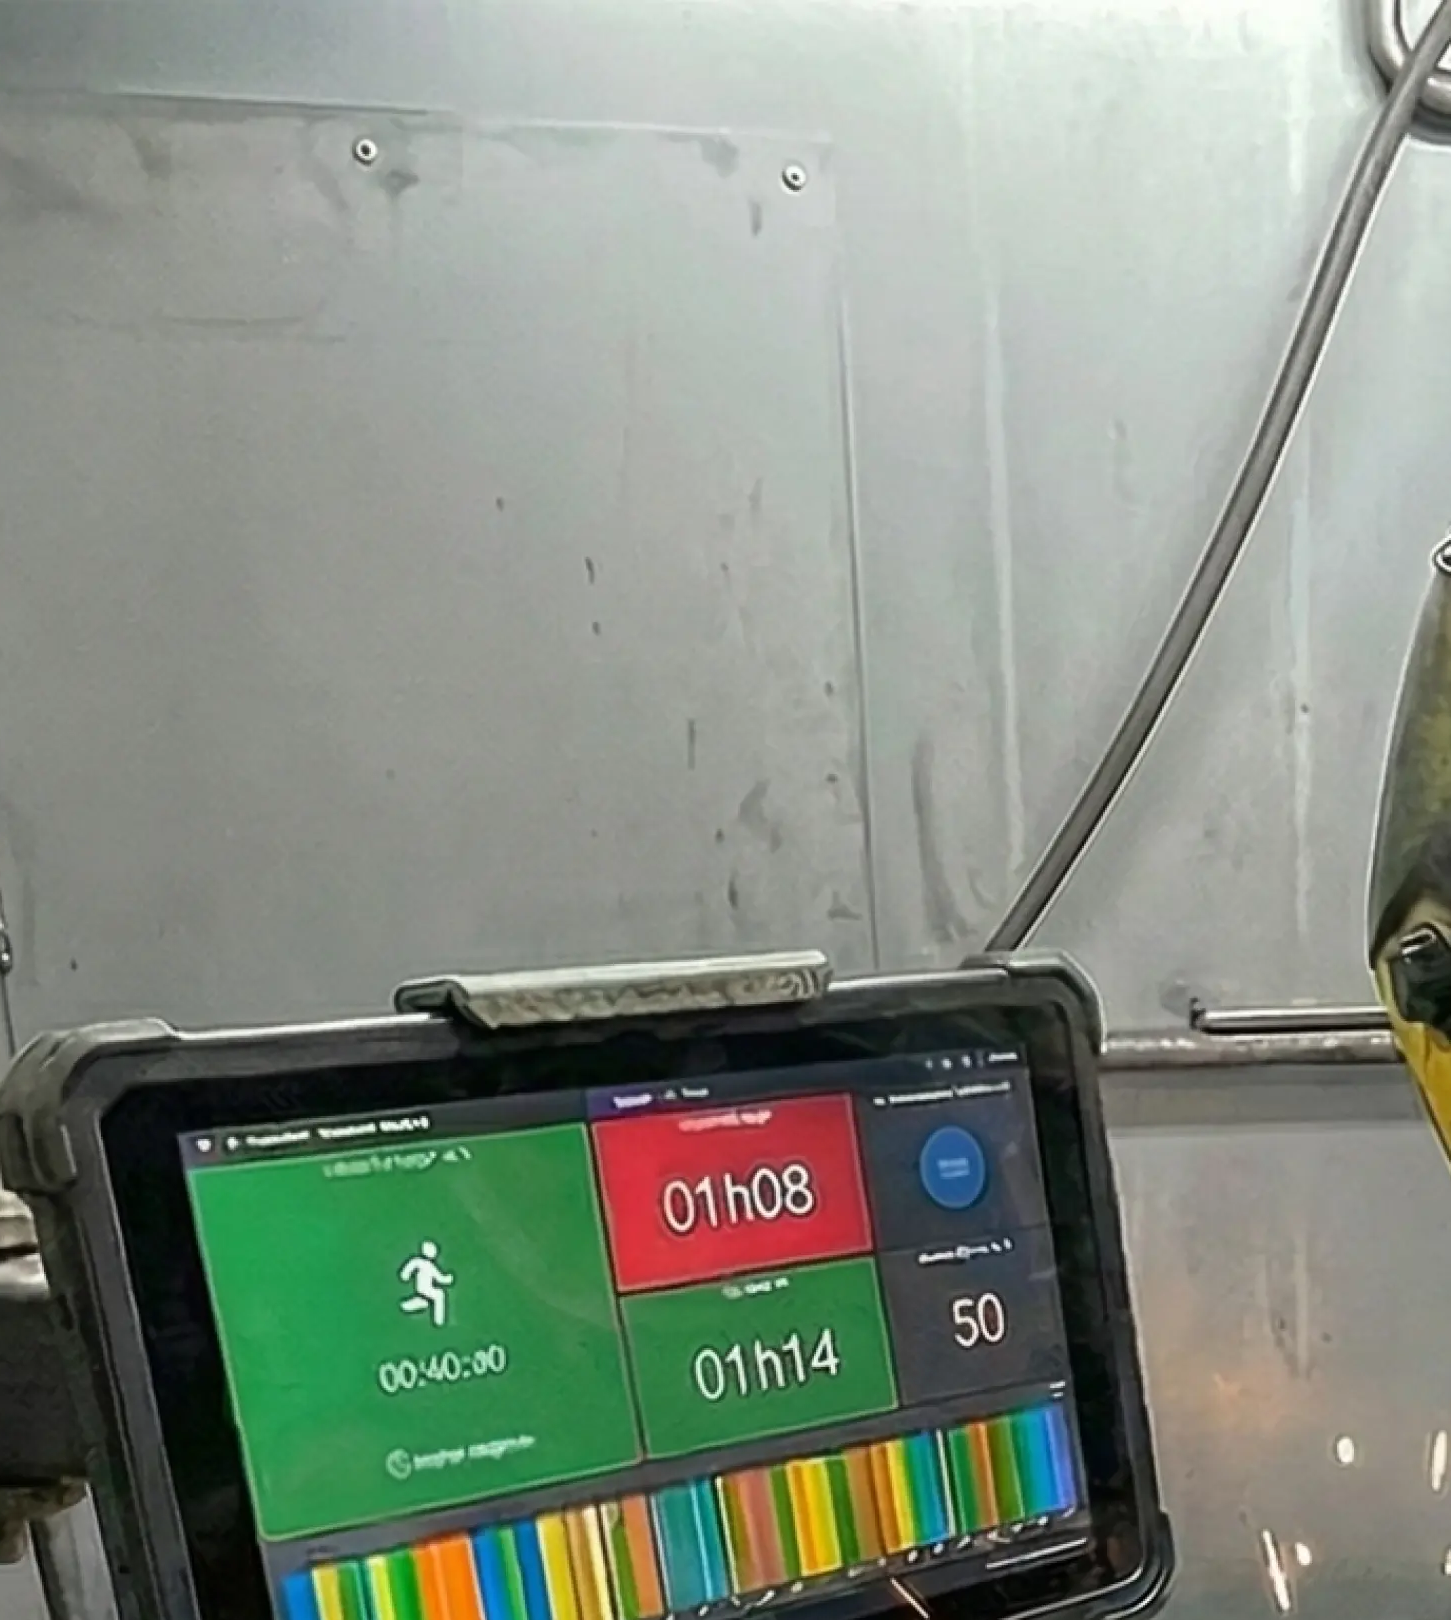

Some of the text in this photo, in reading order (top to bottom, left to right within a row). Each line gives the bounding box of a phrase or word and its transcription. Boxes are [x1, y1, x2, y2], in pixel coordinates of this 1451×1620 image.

[662, 1164, 814, 1233] 01h08
[951, 1292, 1006, 1348] 50
[694, 1329, 840, 1400] 01h14
